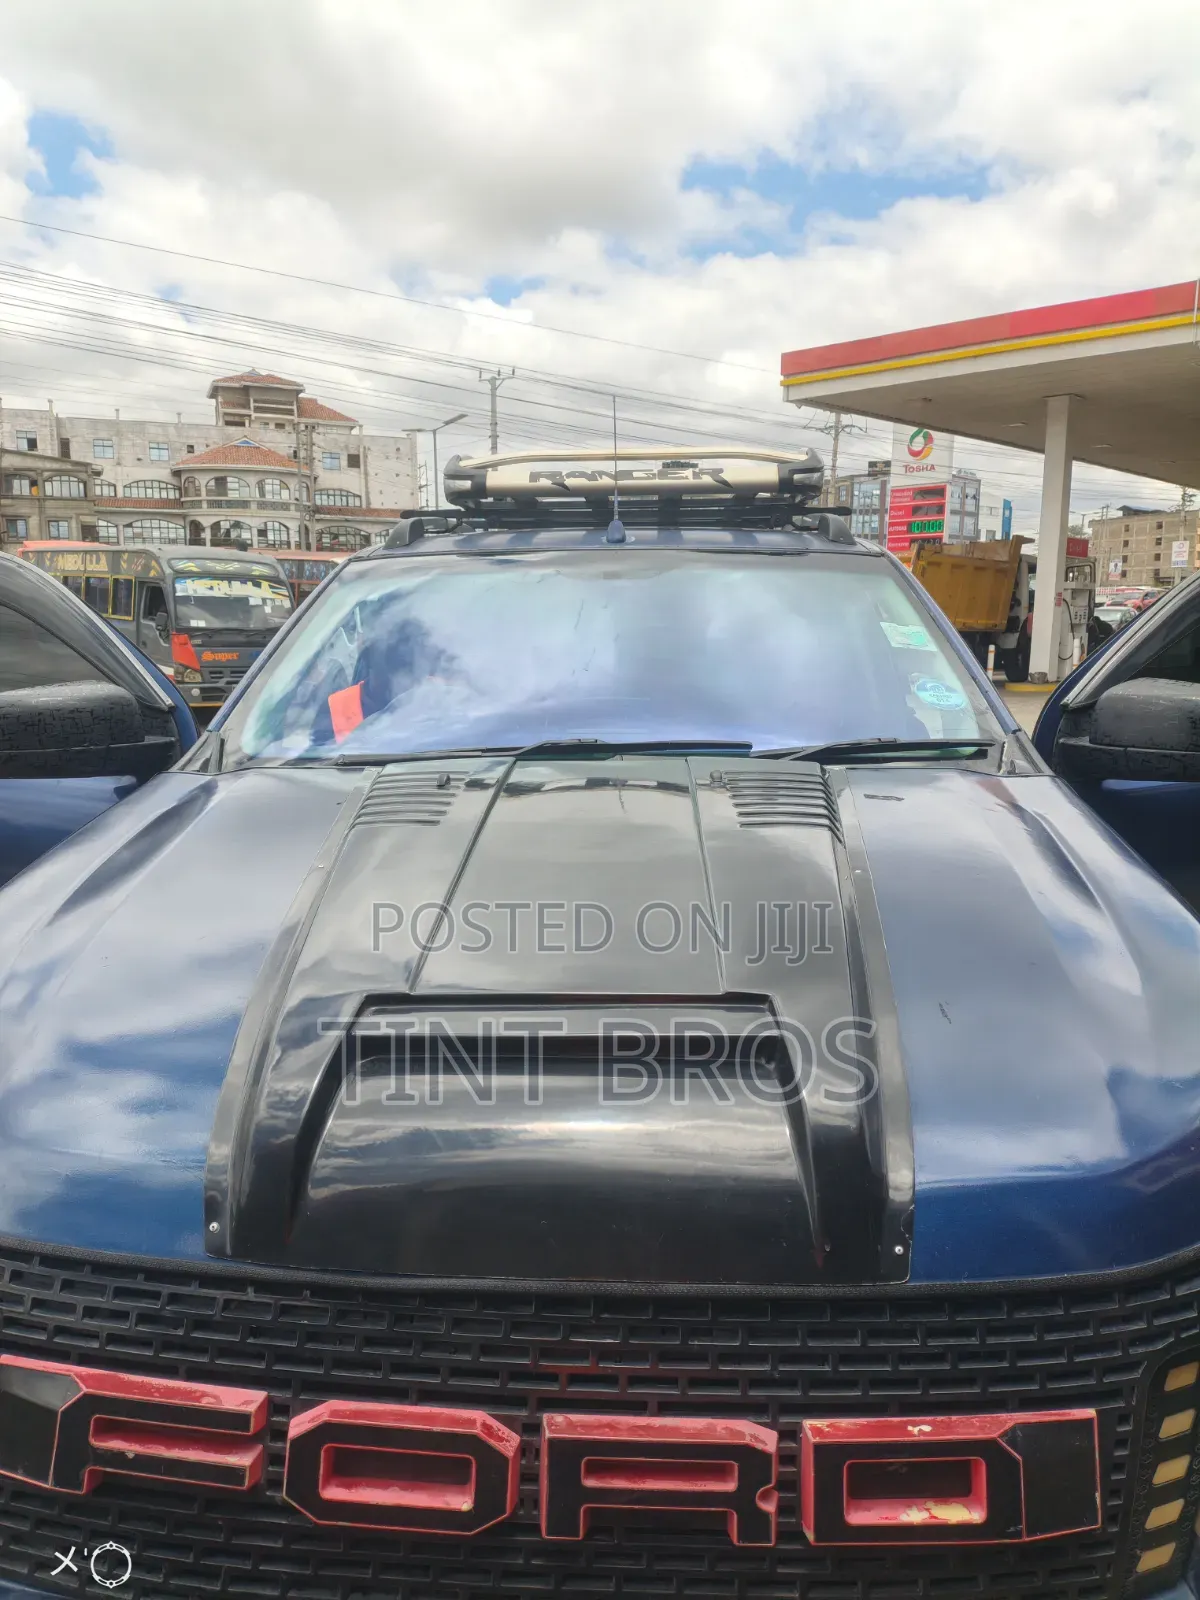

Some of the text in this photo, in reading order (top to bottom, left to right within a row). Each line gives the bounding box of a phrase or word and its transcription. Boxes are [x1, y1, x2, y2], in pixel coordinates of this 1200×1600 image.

[903, 464, 936, 474] TOSHA
[529, 468, 733, 492] RANGER
[202, 651, 239, 662] Super
[15, 1355, 1101, 1548] FORD
